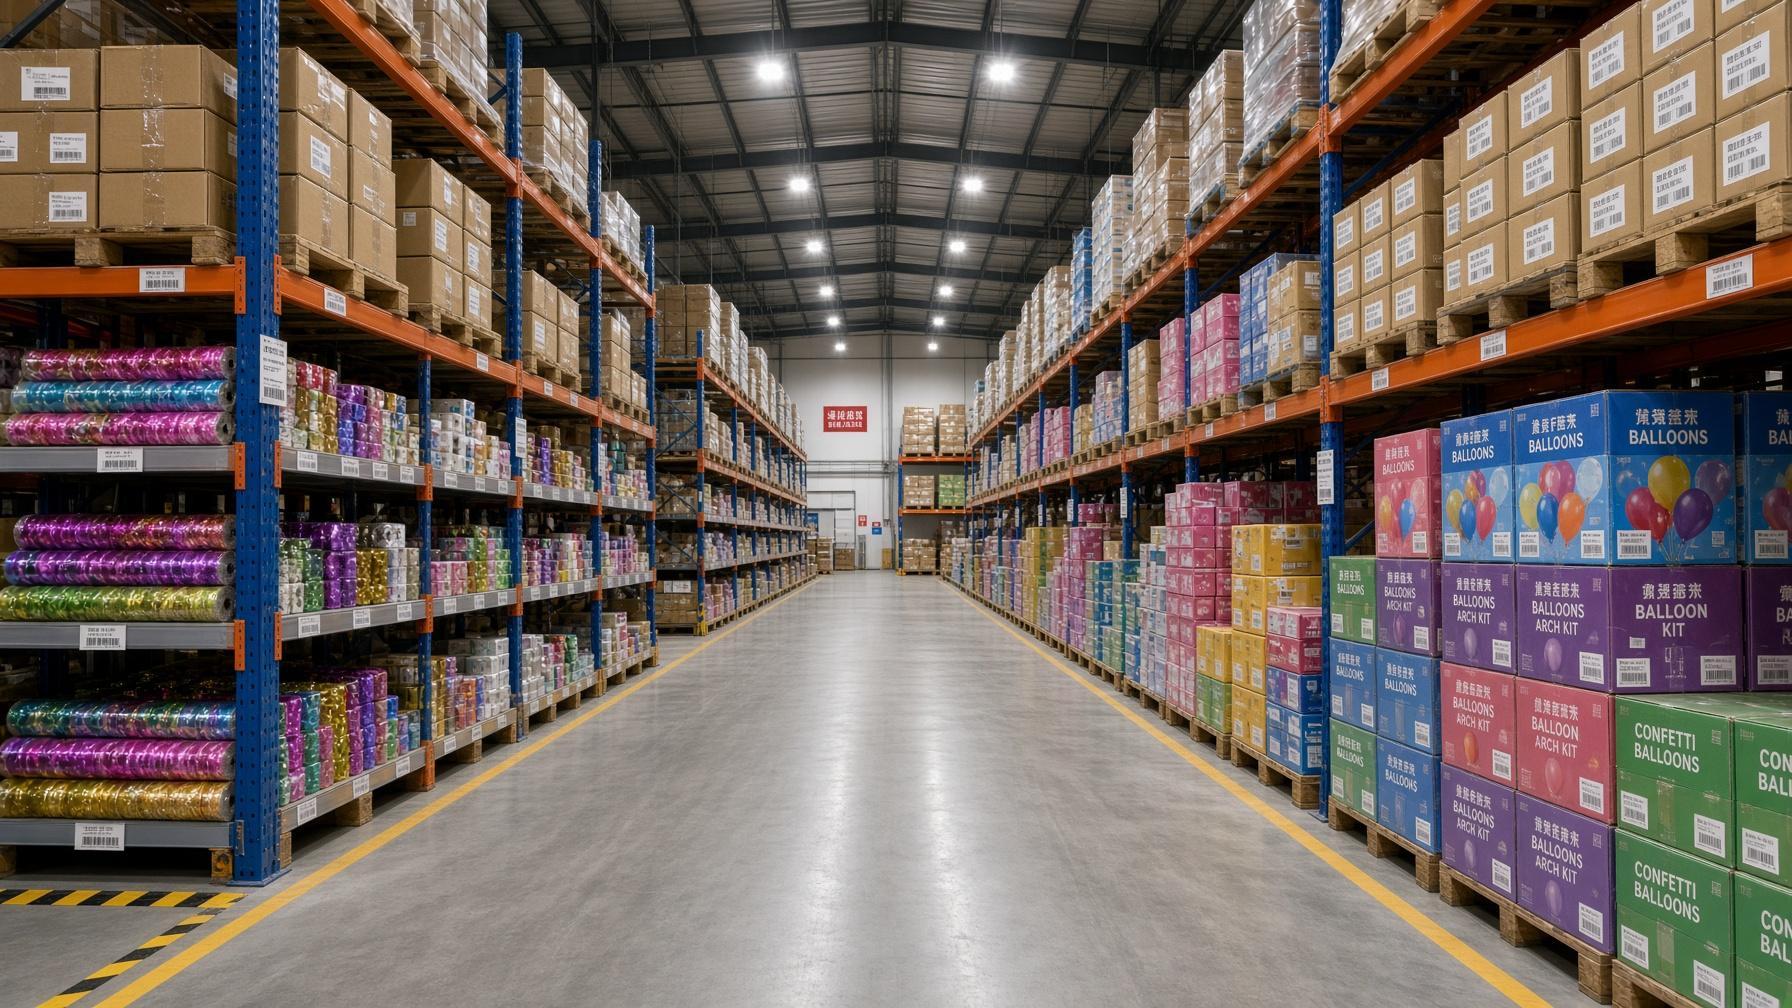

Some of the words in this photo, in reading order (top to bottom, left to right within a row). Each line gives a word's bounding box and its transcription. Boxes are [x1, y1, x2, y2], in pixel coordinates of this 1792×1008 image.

[1528, 433, 1584, 453] BALLOONS
[1629, 429, 1708, 445] BALLOONS
[1452, 445, 1494, 463] BALLOONS
[1382, 460, 1415, 475] BALLOONS
[1453, 594, 1495, 609] BALLOONS
[1532, 601, 1584, 618] BALLOONS
[1635, 603, 1708, 619] BALLOON
[1457, 610, 1476, 624] ARCH
[1478, 612, 1491, 625] KIT
[1535, 619, 1559, 634] ARCH
[1563, 621, 1578, 636] KIT
[1662, 622, 1685, 637] KIT
[1452, 696, 1495, 718] BALLOONS
[1456, 713, 1475, 729] ARCH
[1478, 718, 1490, 733] KIT
[1531, 716, 1579, 741] BALLOON
[1535, 735, 1559, 754] ARCH
[1562, 740, 1578, 758] KIT
[1634, 722, 1696, 751] CONFETTI
[1634, 742, 1700, 773] BALLOONS
[1453, 799, 1495, 829] BALLOONS
[1456, 817, 1476, 836] ARCH
[1477, 825, 1490, 841] KIT
[1531, 835, 1583, 869] BALLOONS
[1535, 855, 1559, 877] ARCH
[1562, 866, 1578, 885] KIT
[1634, 860, 1697, 900] CONFETTI
[1634, 881, 1700, 924] BALLOONS
